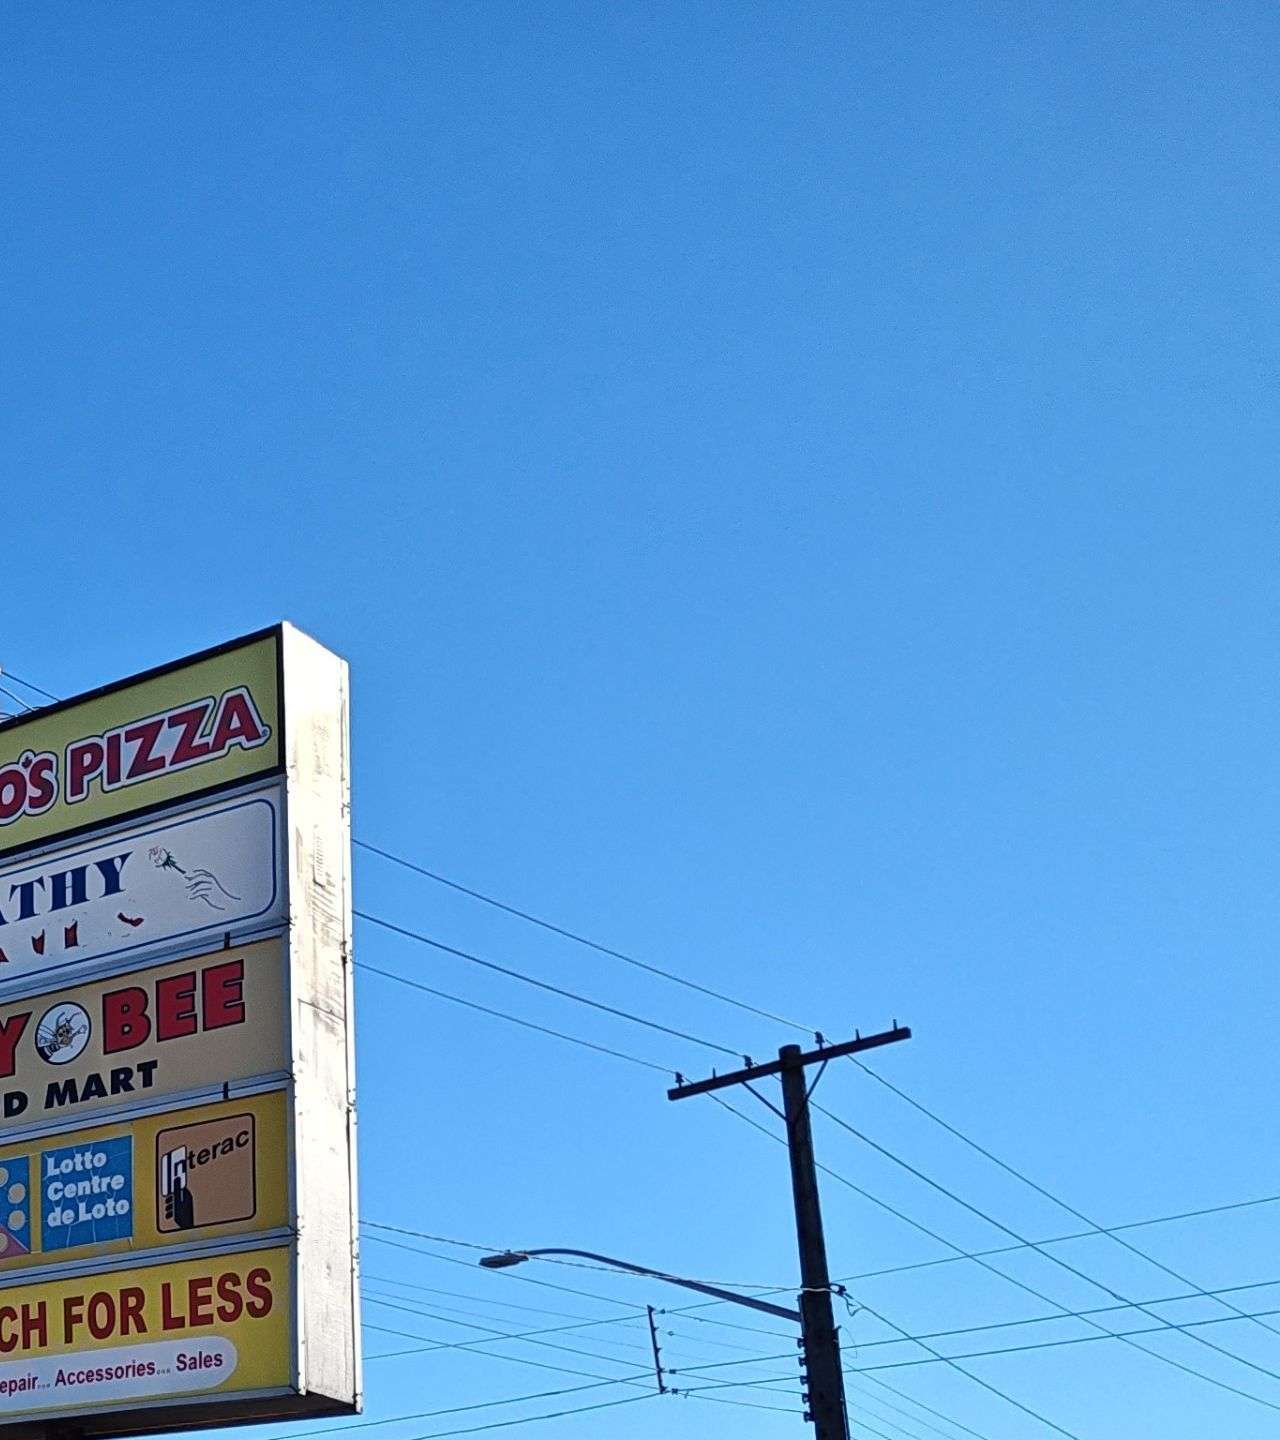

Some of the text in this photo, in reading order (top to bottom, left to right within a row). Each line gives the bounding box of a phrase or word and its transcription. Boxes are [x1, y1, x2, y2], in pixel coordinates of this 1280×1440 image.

[70, 694, 262, 797] PIZZA
[102, 958, 246, 1055] BEE
[44, 1060, 159, 1110] MART
[46, 1151, 107, 1176] Lotto
[47, 1174, 125, 1201] Centre
[47, 1198, 130, 1227] de Loto
[63, 1286, 147, 1345] FOR
[161, 1267, 273, 1331] LESS
[176, 1352, 224, 1373] Sales
